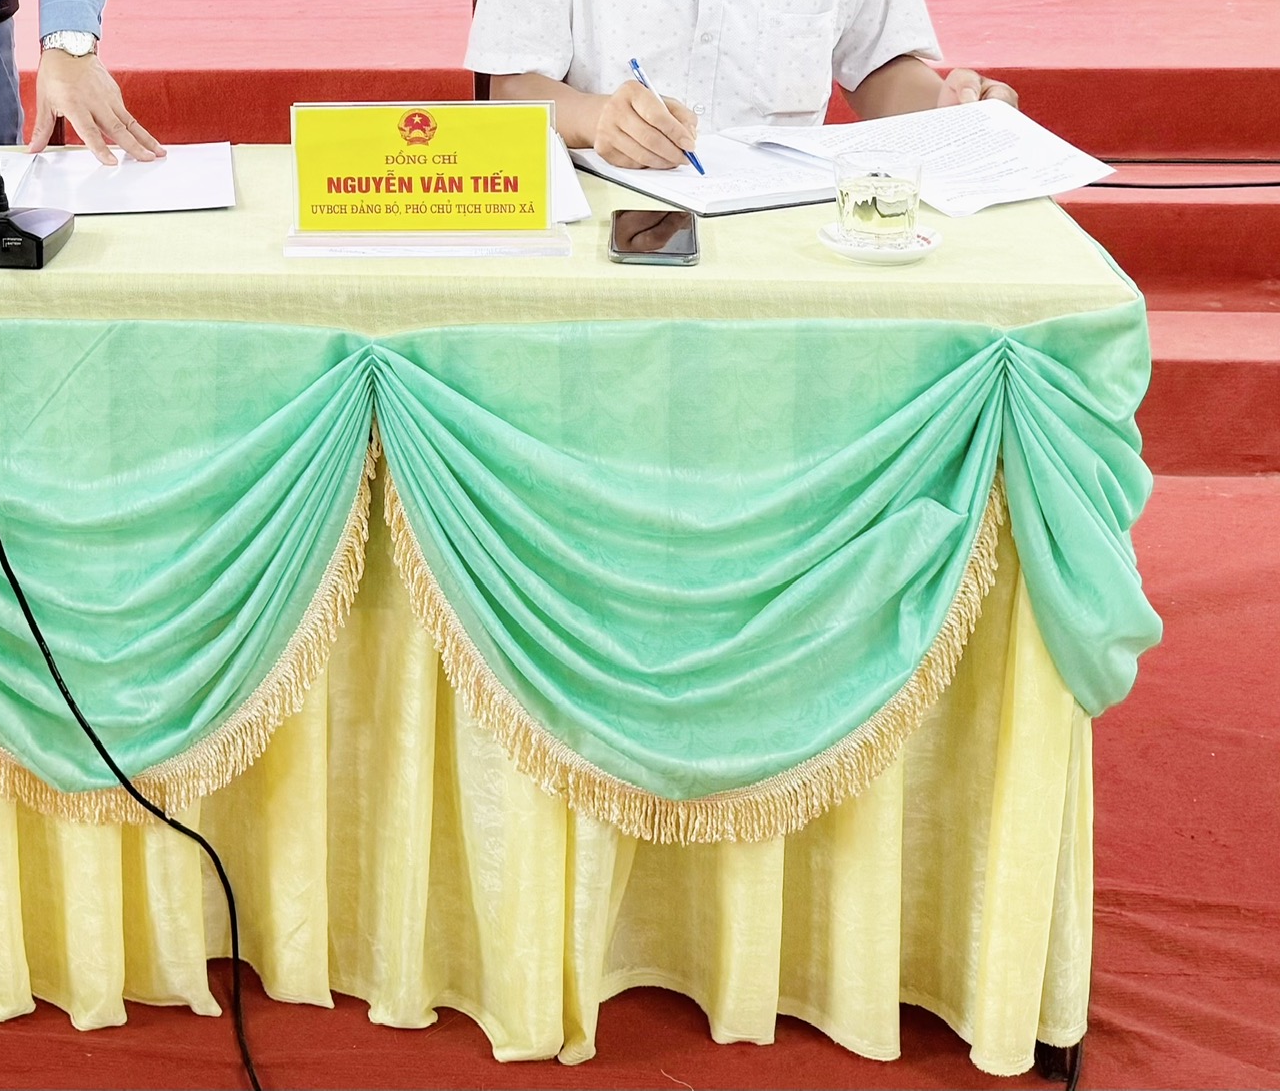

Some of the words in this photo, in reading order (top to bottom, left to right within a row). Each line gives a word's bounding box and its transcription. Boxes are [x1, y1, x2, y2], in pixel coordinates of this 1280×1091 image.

[385, 150, 428, 165] ĐỒNG
[432, 151, 458, 165] CHÍ
[327, 170, 413, 194] NGUYỄN
[419, 171, 463, 193] VĂN
[470, 169, 519, 192] TIẾN
[311, 204, 347, 214] UVBCH
[351, 200, 381, 214] ĐẢNG
[405, 201, 427, 214] PHÓ
[430, 199, 452, 214] CHỦ
[456, 203, 482, 217] TỊCH
[485, 204, 516, 213] UBND
